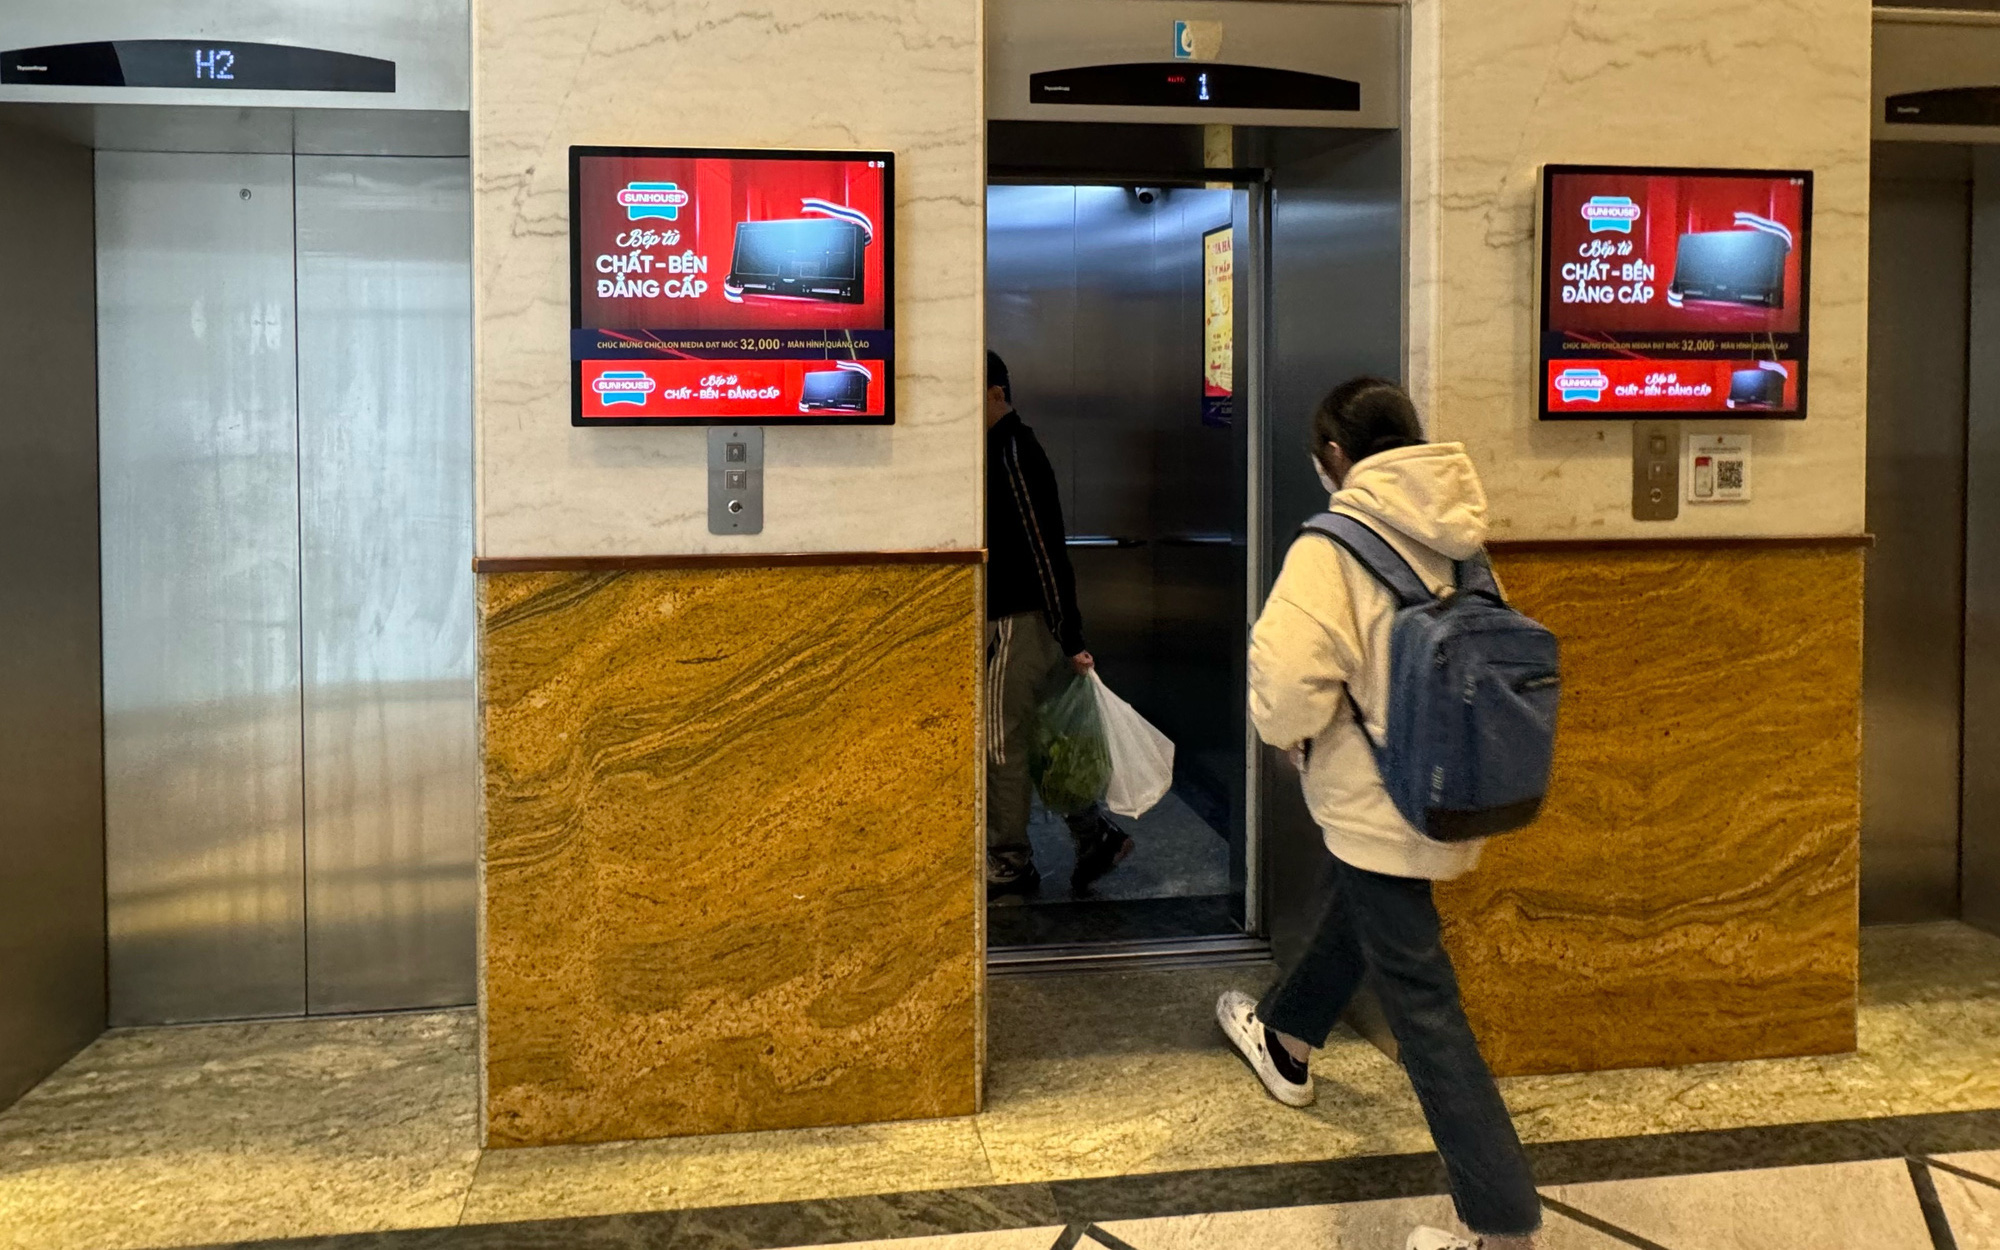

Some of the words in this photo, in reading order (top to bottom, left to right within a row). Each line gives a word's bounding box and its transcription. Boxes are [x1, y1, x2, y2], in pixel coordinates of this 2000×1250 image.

[196, 49, 234, 79] H2
[1199, 73, 1209, 100] 1
[624, 193, 681, 203] SUNHOUSE
[616, 228, 660, 249] Bếp
[662, 229, 680, 246] từ
[596, 249, 654, 273] CHẤT
[668, 249, 707, 274] BỀN
[1562, 258, 1610, 281] CHẤT
[597, 271, 660, 298] ĐẲNG
[664, 274, 708, 298] CẤP
[1618, 281, 1655, 304] CẤP
[680, 341, 704, 349] MEDIA
[598, 381, 649, 390] SUNHOUSE
[664, 386, 692, 399] CHẤT
[758, 386, 780, 399] CẤP
